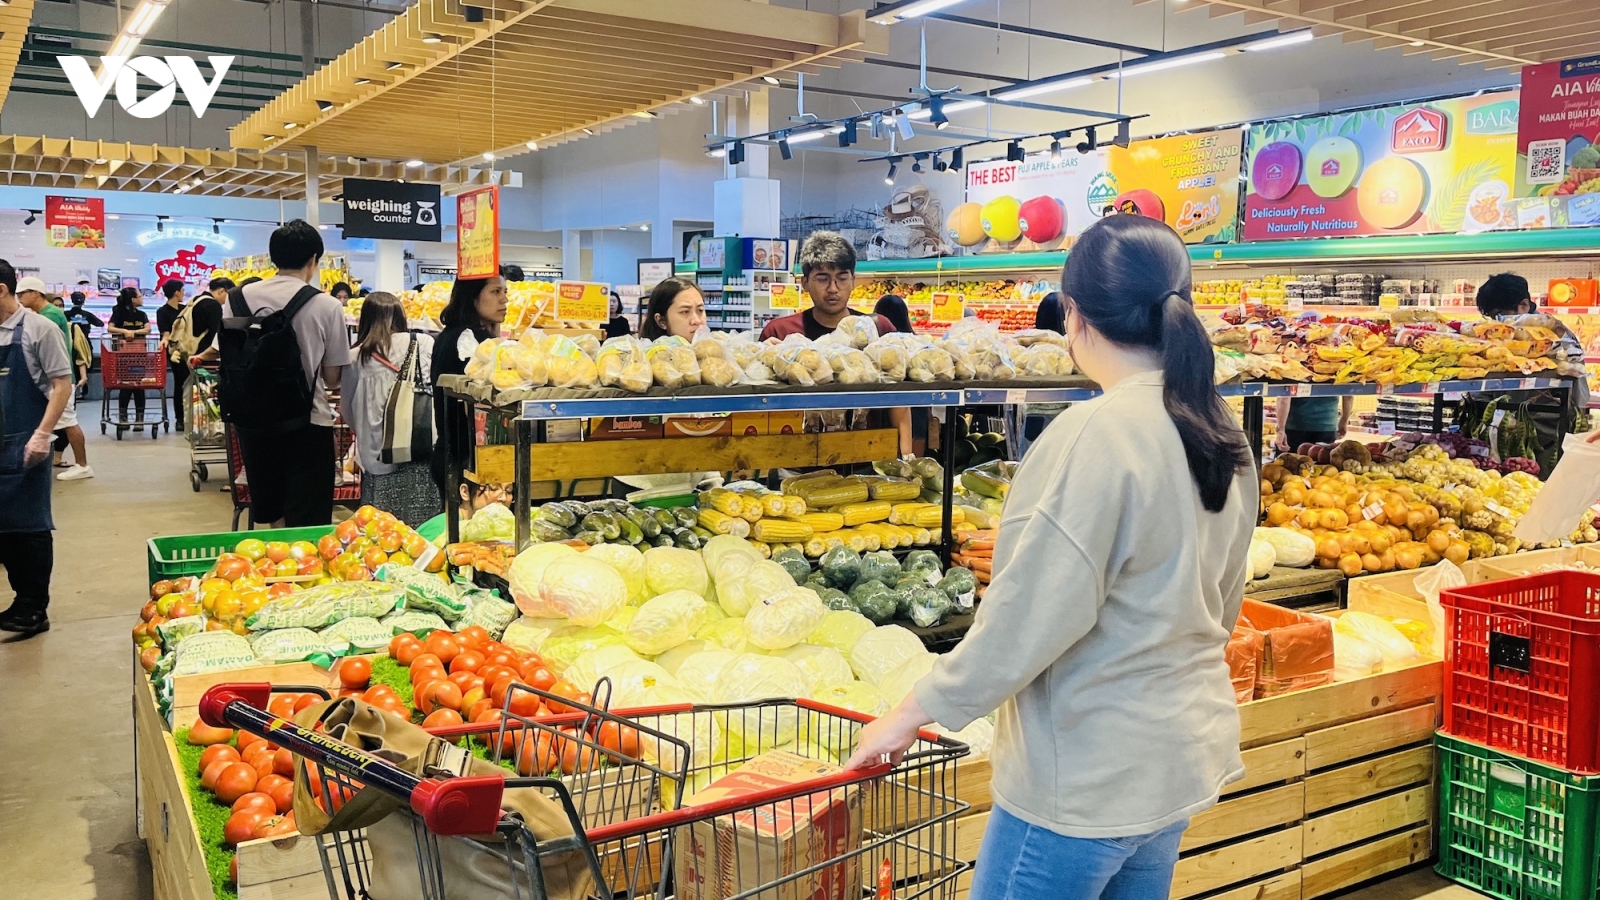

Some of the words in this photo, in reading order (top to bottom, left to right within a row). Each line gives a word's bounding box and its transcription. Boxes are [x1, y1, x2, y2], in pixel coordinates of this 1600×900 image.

[1551, 81, 1583, 98] AIA
[1539, 112, 1566, 123] MAKAN
[1567, 109, 1589, 120] BUAH
[1182, 135, 1218, 151] SWEET
[1402, 136, 1432, 147] EXCO
[1162, 149, 1212, 167] CRUNCHY
[1215, 145, 1239, 159] AND
[970, 169, 988, 186] THE
[991, 165, 1017, 184] BEST
[1031, 160, 1051, 172] APPLE
[1170, 160, 1227, 179] FRAGRANT
[1178, 175, 1216, 191] APPLE!
[347, 198, 412, 215] weighing
[1251, 206, 1299, 219] Deliciously
[1301, 204, 1325, 215] Fresh
[373, 214, 412, 223] counter
[1267, 221, 1309, 233] Naturally
[1311, 218, 1358, 230] Nutritious
[159, 261, 186, 277] Baby
[421, 267, 447, 275] FROZEN
[613, 416, 642, 430] bamboo
